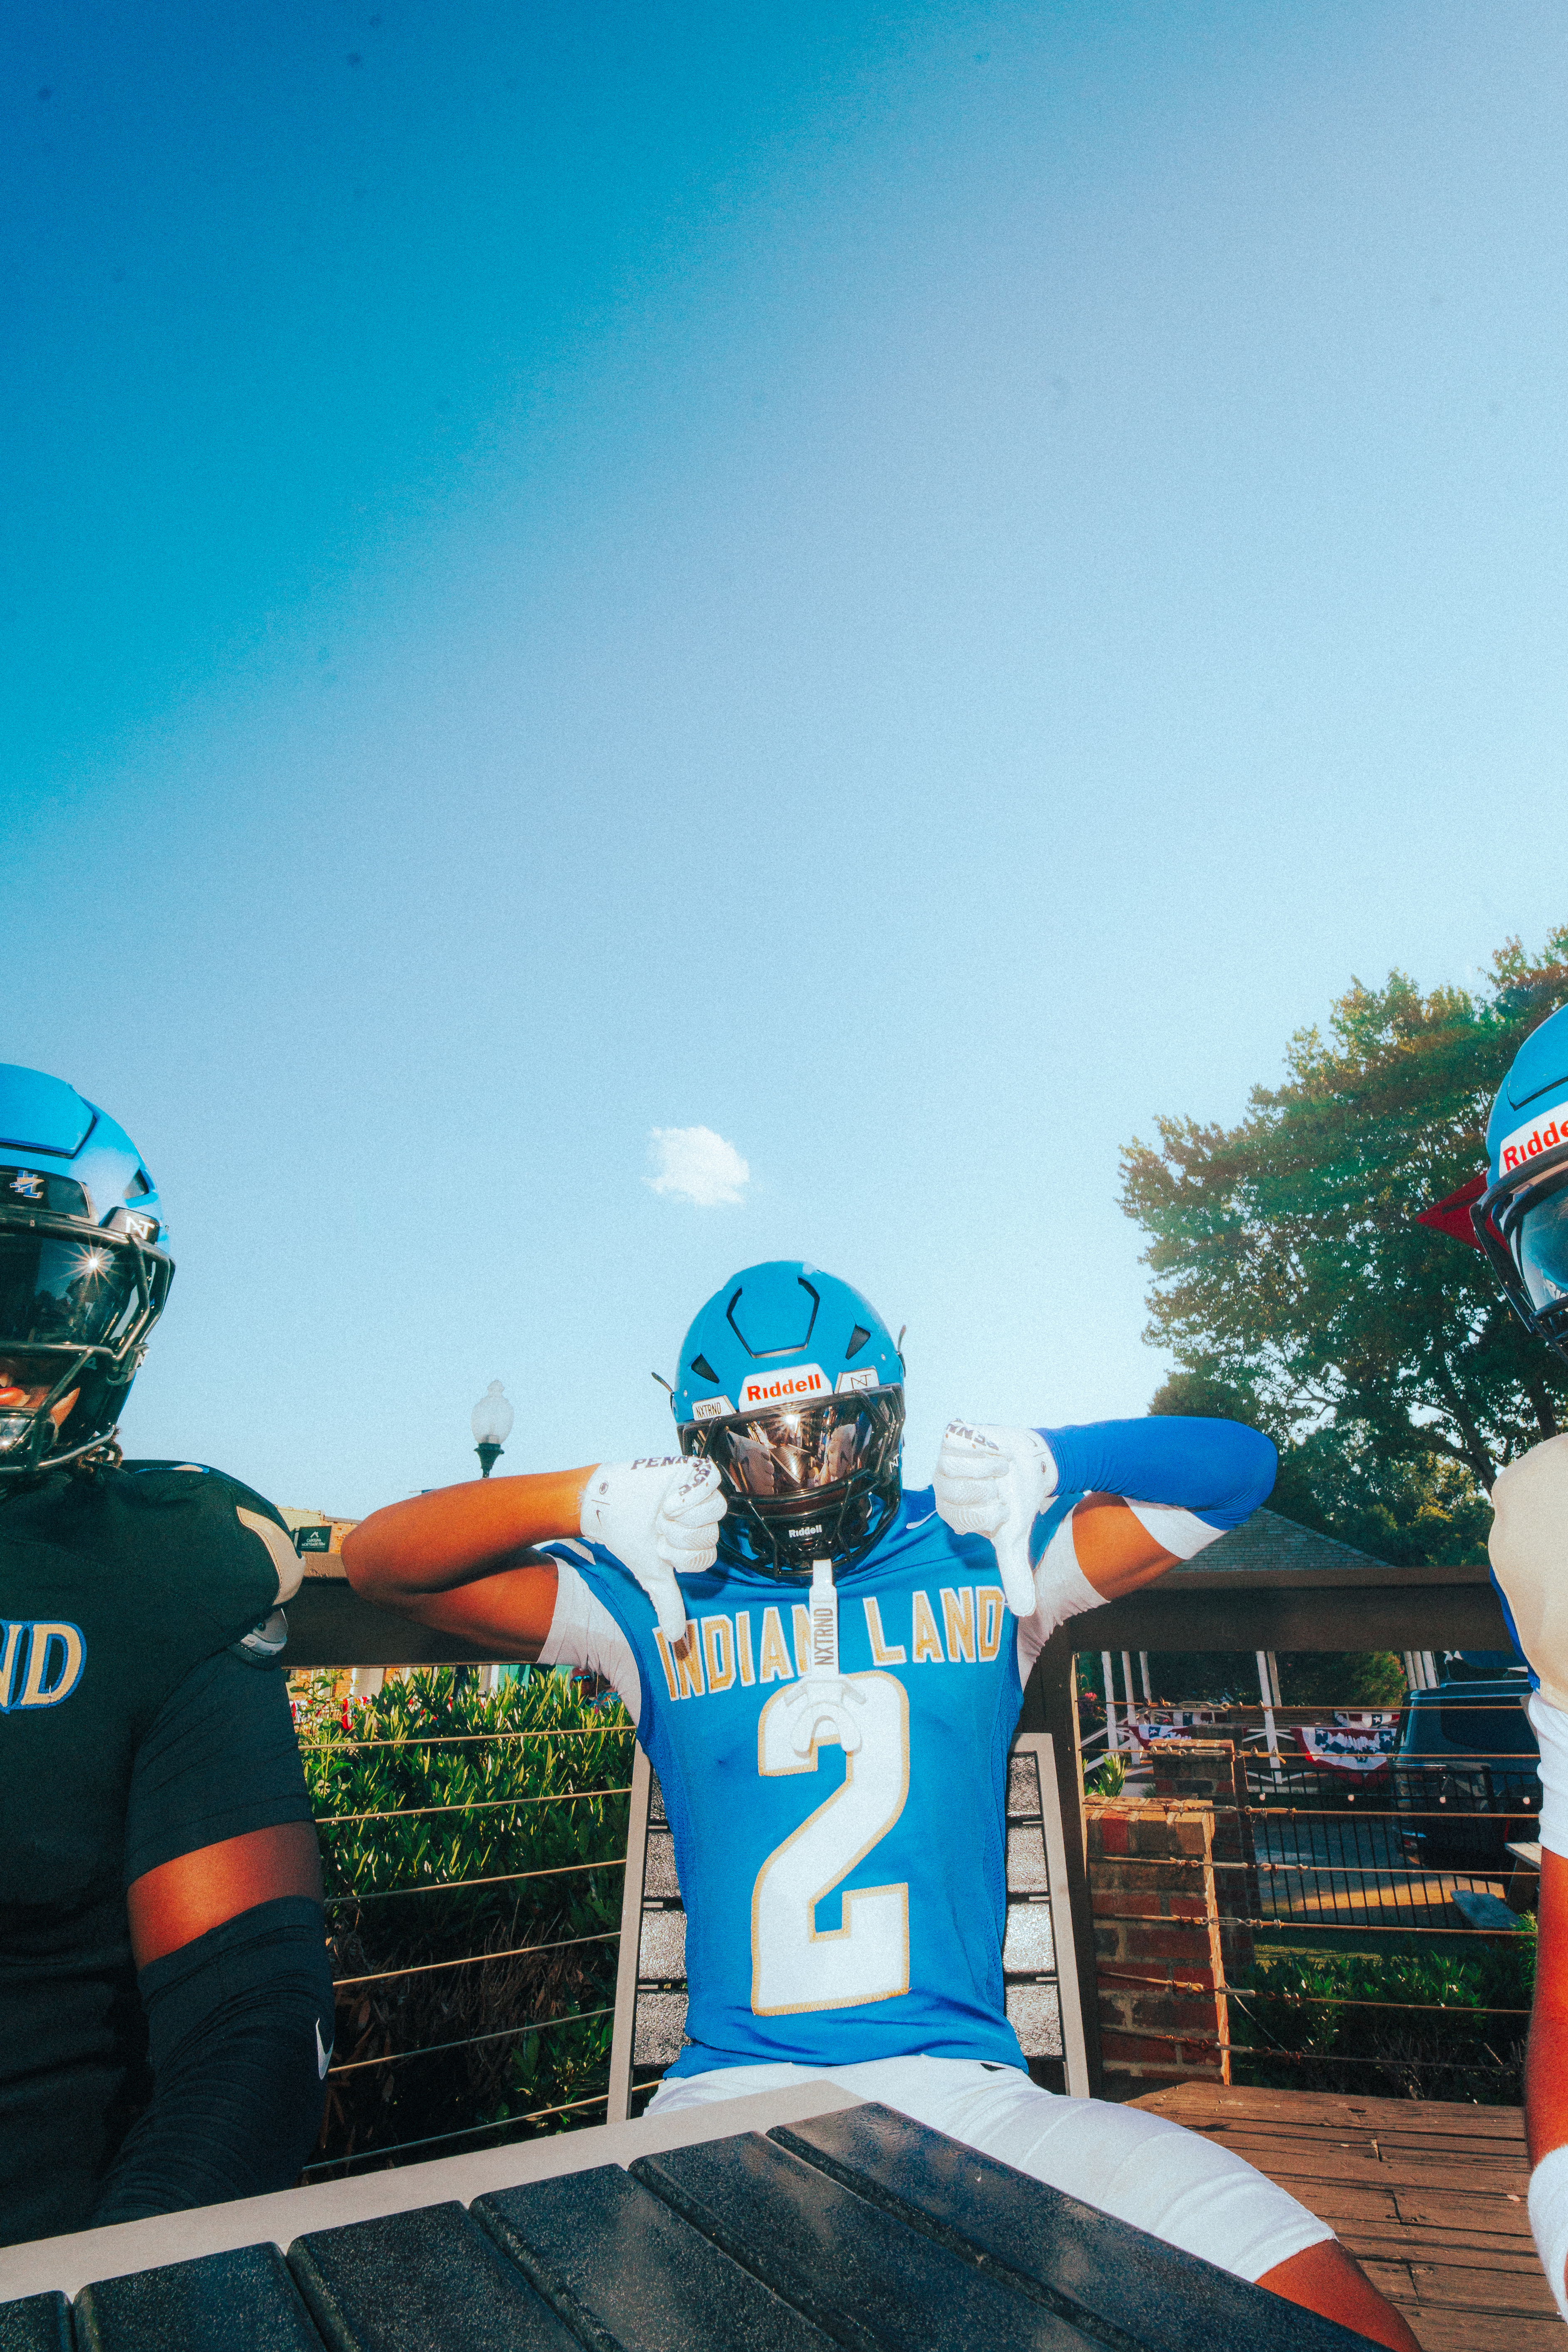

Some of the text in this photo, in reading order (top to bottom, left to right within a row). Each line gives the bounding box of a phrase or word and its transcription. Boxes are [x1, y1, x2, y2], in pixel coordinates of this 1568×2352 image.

[747, 1374, 821, 1401] Riddell
[696, 1402, 721, 1418] NXTRND
[631, 1456, 689, 1470] PENN
[788, 1524, 823, 1538] Riddell
[813, 1608, 834, 1665] NXTRND
[862, 1586, 1006, 1666] LAND
[752, 1670, 911, 2016] 2
